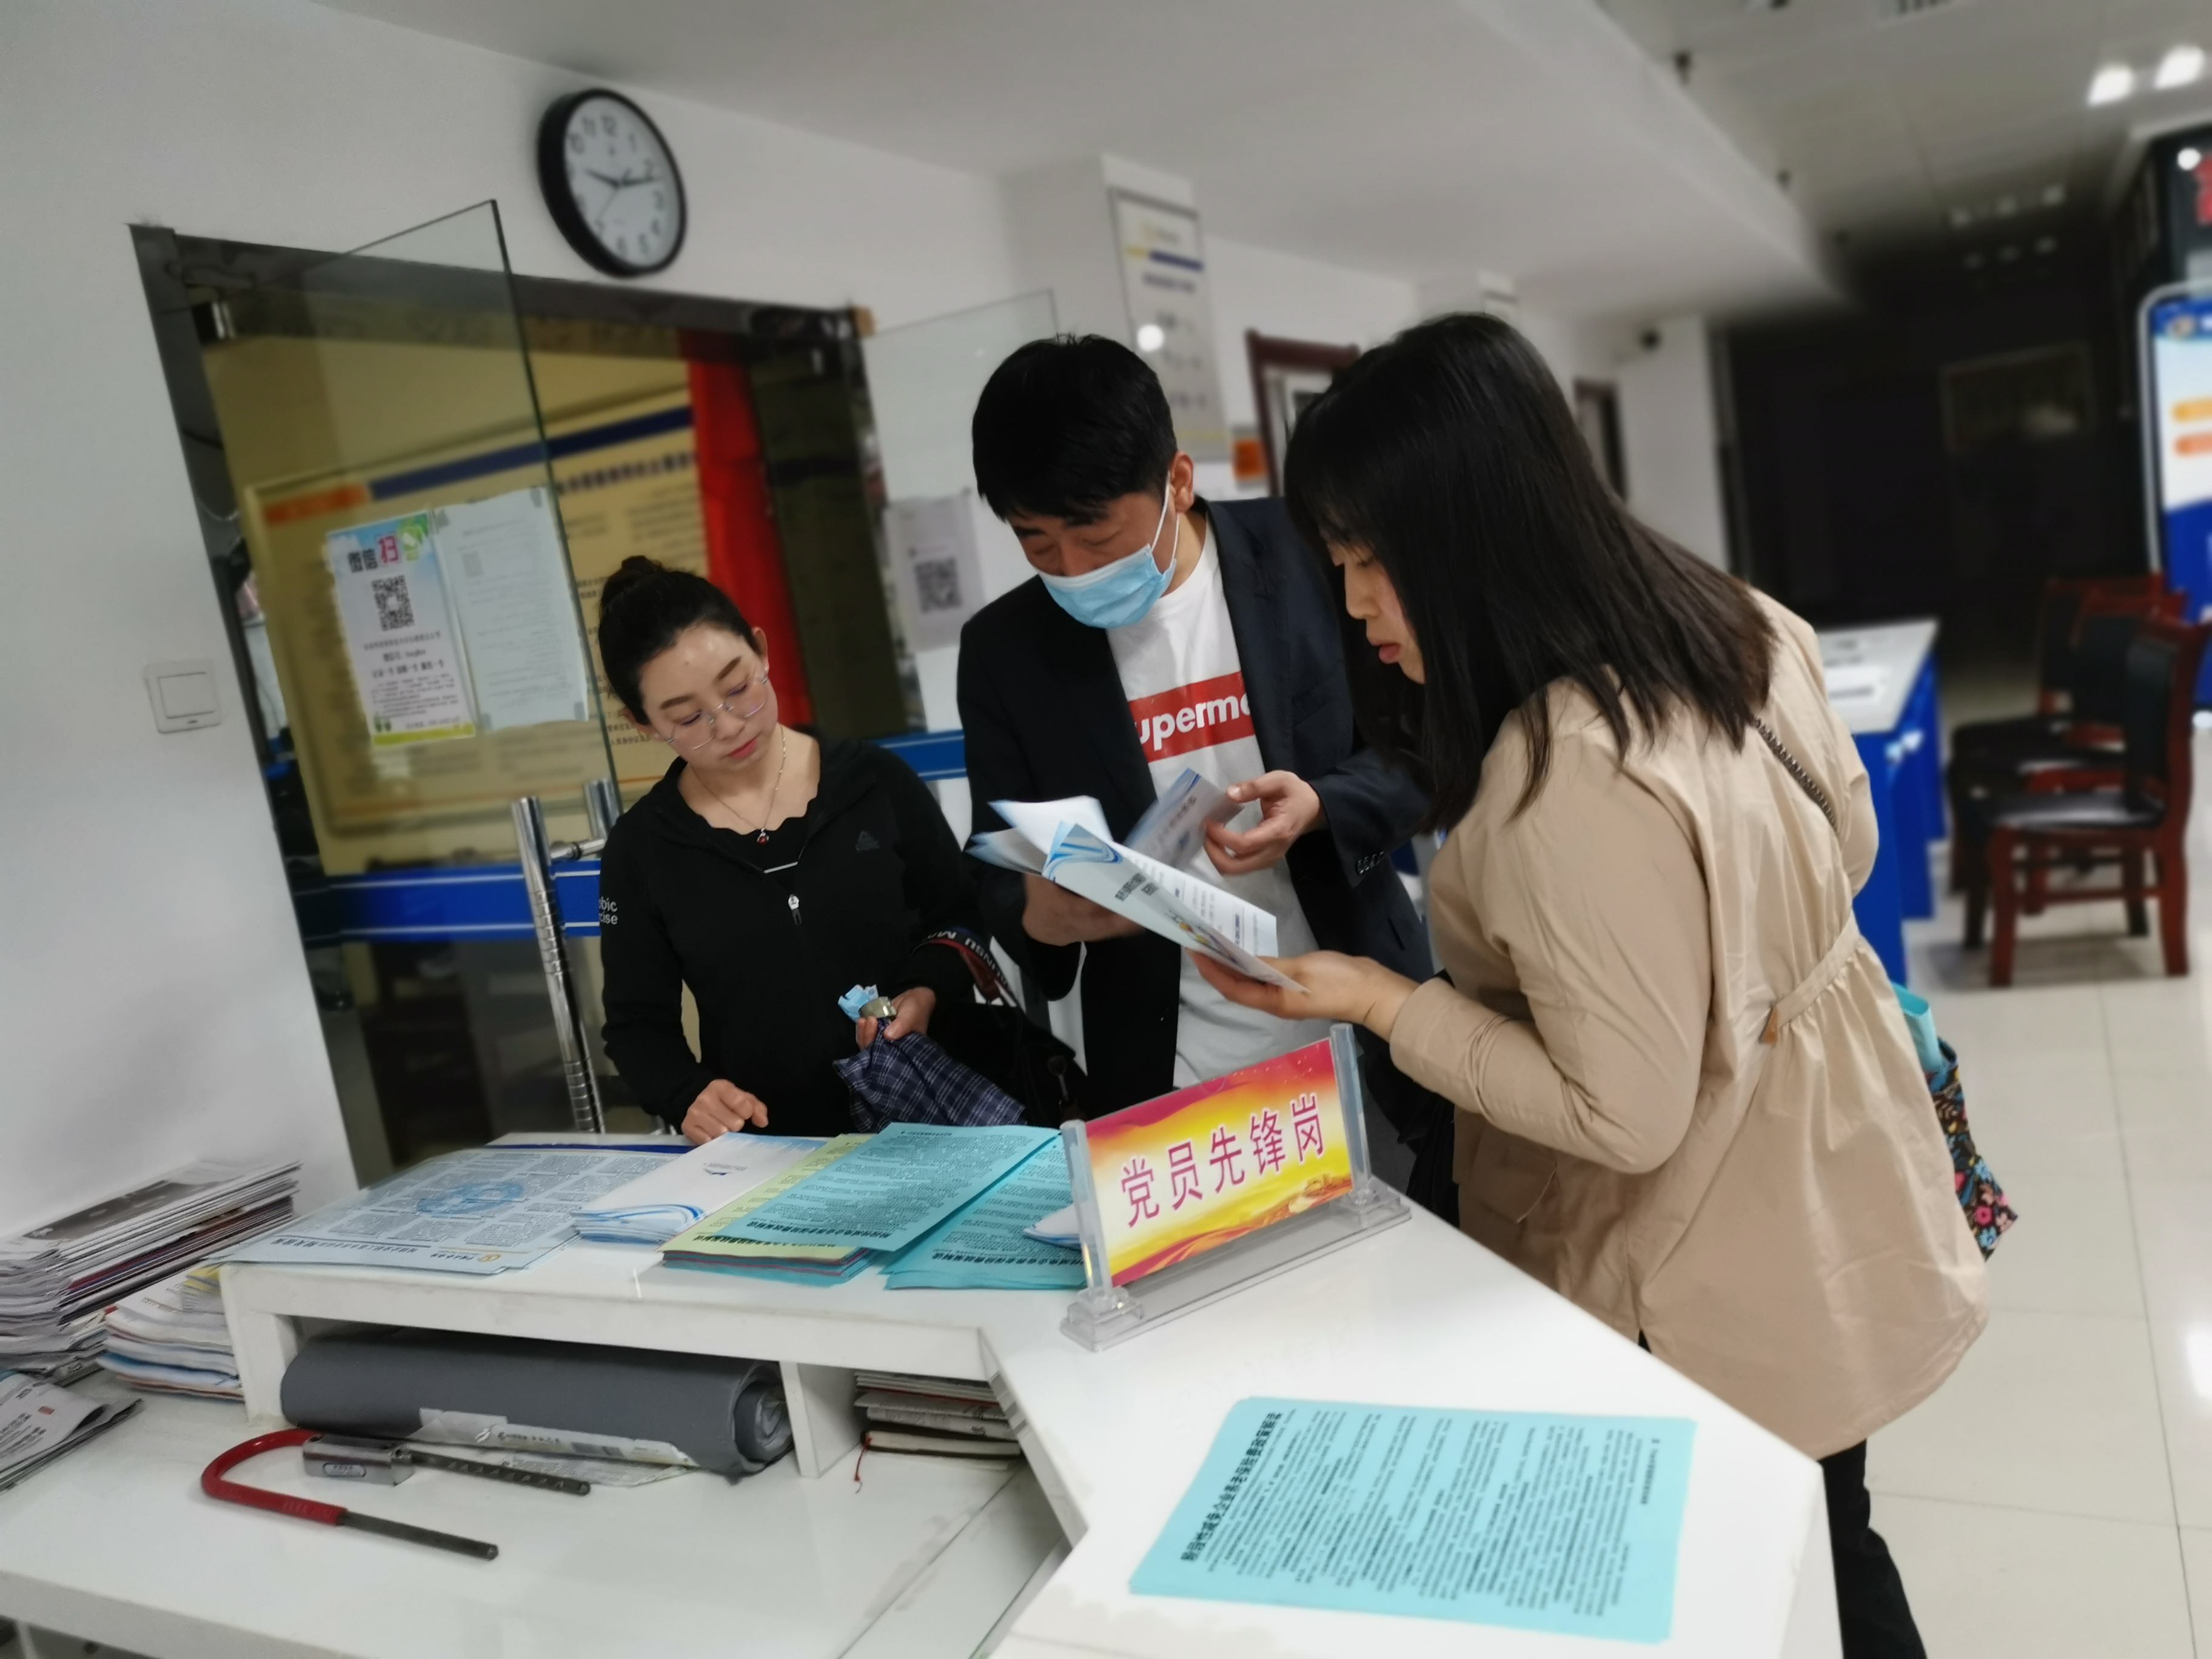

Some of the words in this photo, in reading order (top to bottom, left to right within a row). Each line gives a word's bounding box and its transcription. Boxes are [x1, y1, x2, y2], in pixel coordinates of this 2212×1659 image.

[1121, 1095, 1324, 1228] 党员先锋岗
